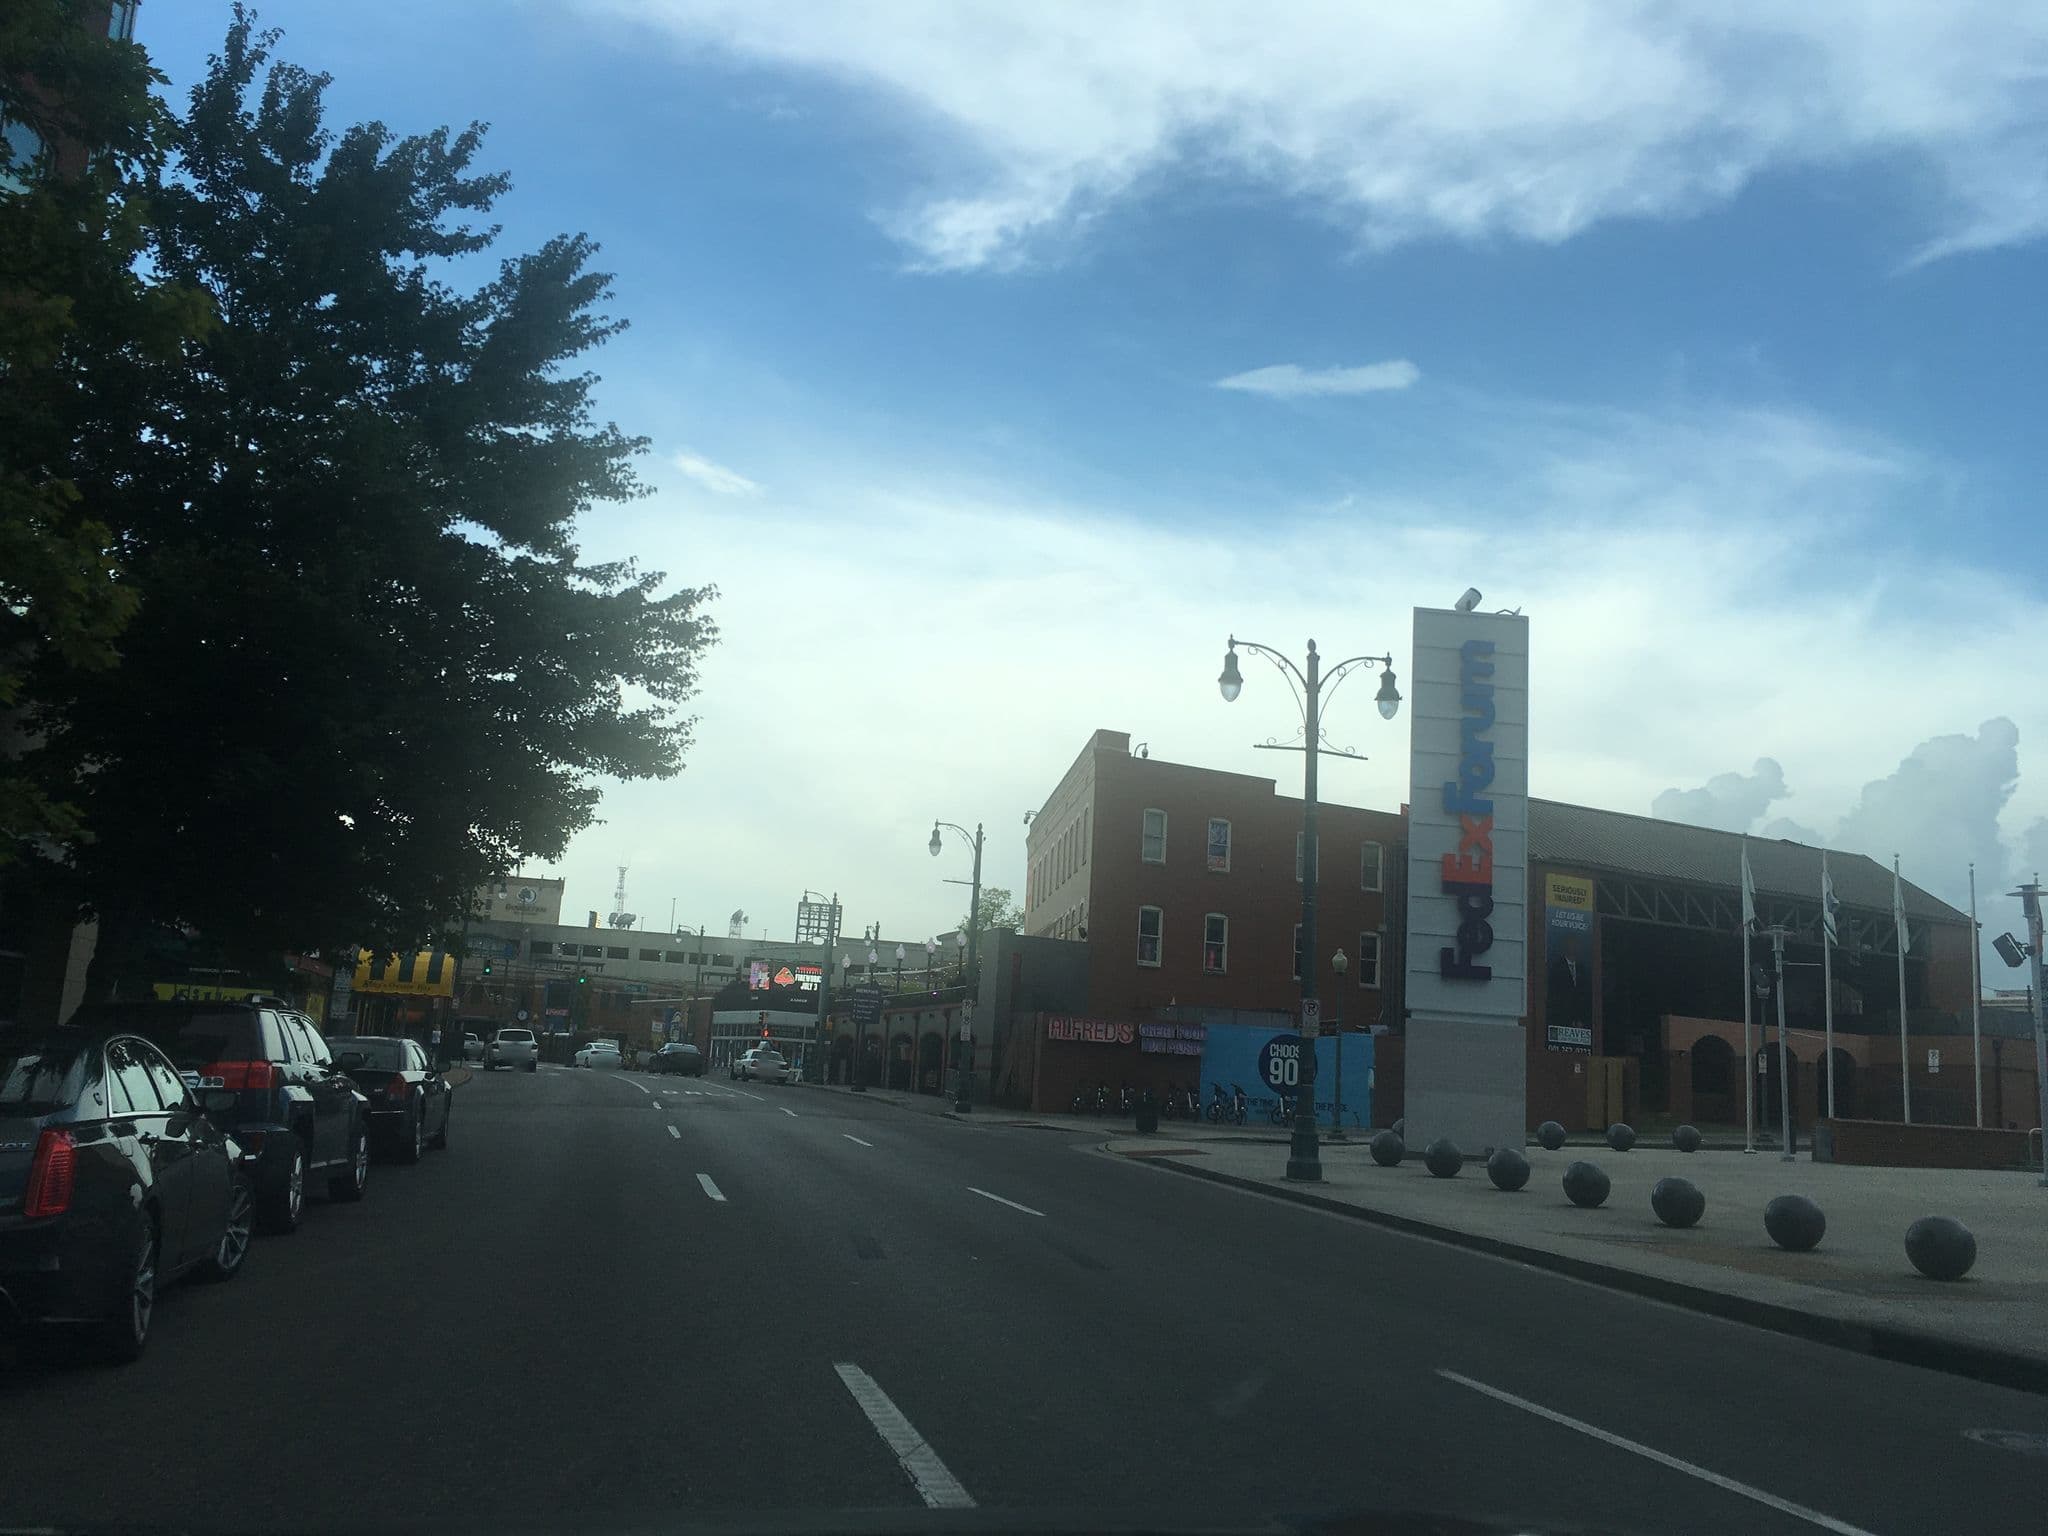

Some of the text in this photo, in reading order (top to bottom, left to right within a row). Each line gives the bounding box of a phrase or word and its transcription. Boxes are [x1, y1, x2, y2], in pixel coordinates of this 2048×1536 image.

[1552, 884, 1587, 897] SERIOUSLY
[1556, 911, 1585, 921] LET US BE
[1552, 919, 1568, 928] YOUR
[813, 983, 818, 991] 3
[1048, 1016, 1134, 1045] ALFRED'S
[1559, 1028, 1591, 1039] REAVES
[1269, 1043, 1299, 1059] CHOOS
[1269, 1057, 1299, 1086] 90
[1315, 1103, 1327, 1111] THE
